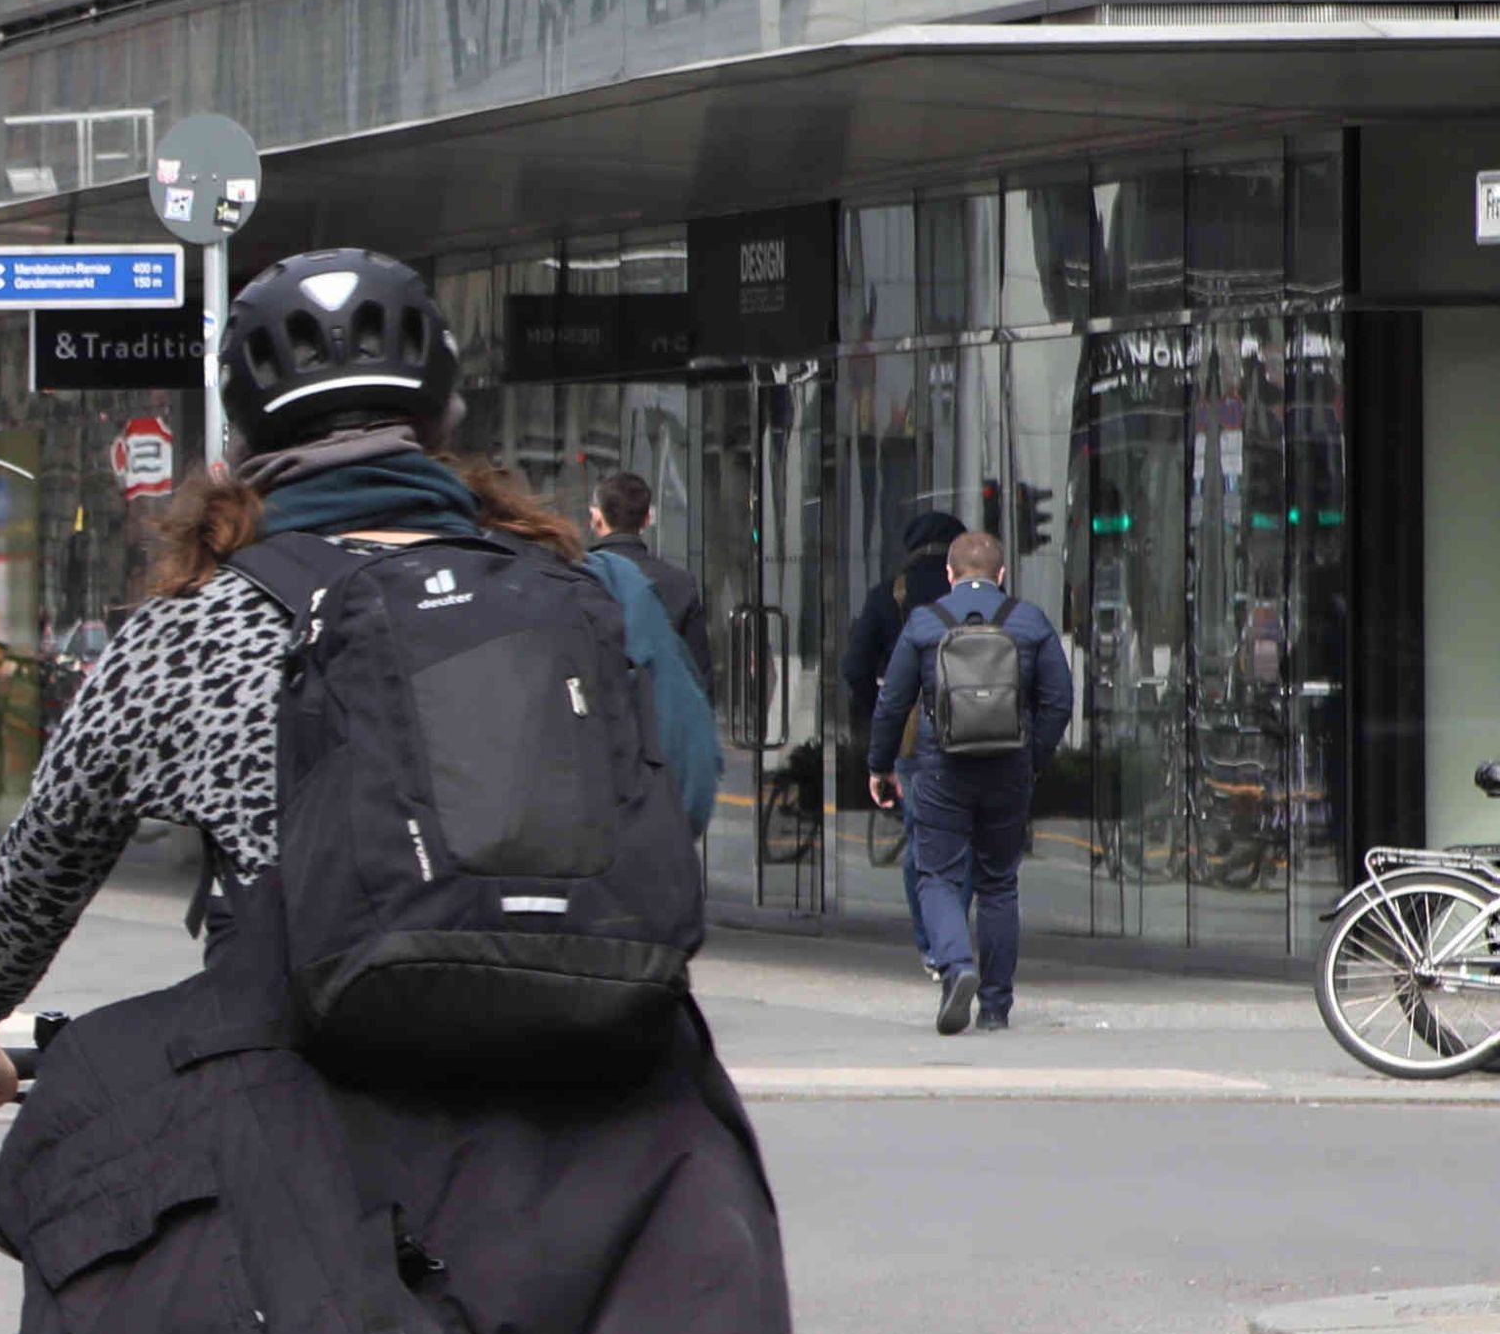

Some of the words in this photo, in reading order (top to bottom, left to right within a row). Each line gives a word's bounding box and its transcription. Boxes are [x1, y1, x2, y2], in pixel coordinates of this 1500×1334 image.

[740, 241, 785, 282] DESIGN
[152, 264, 163, 275] m
[152, 279, 163, 288] m
[417, 592, 474, 610] deuter
